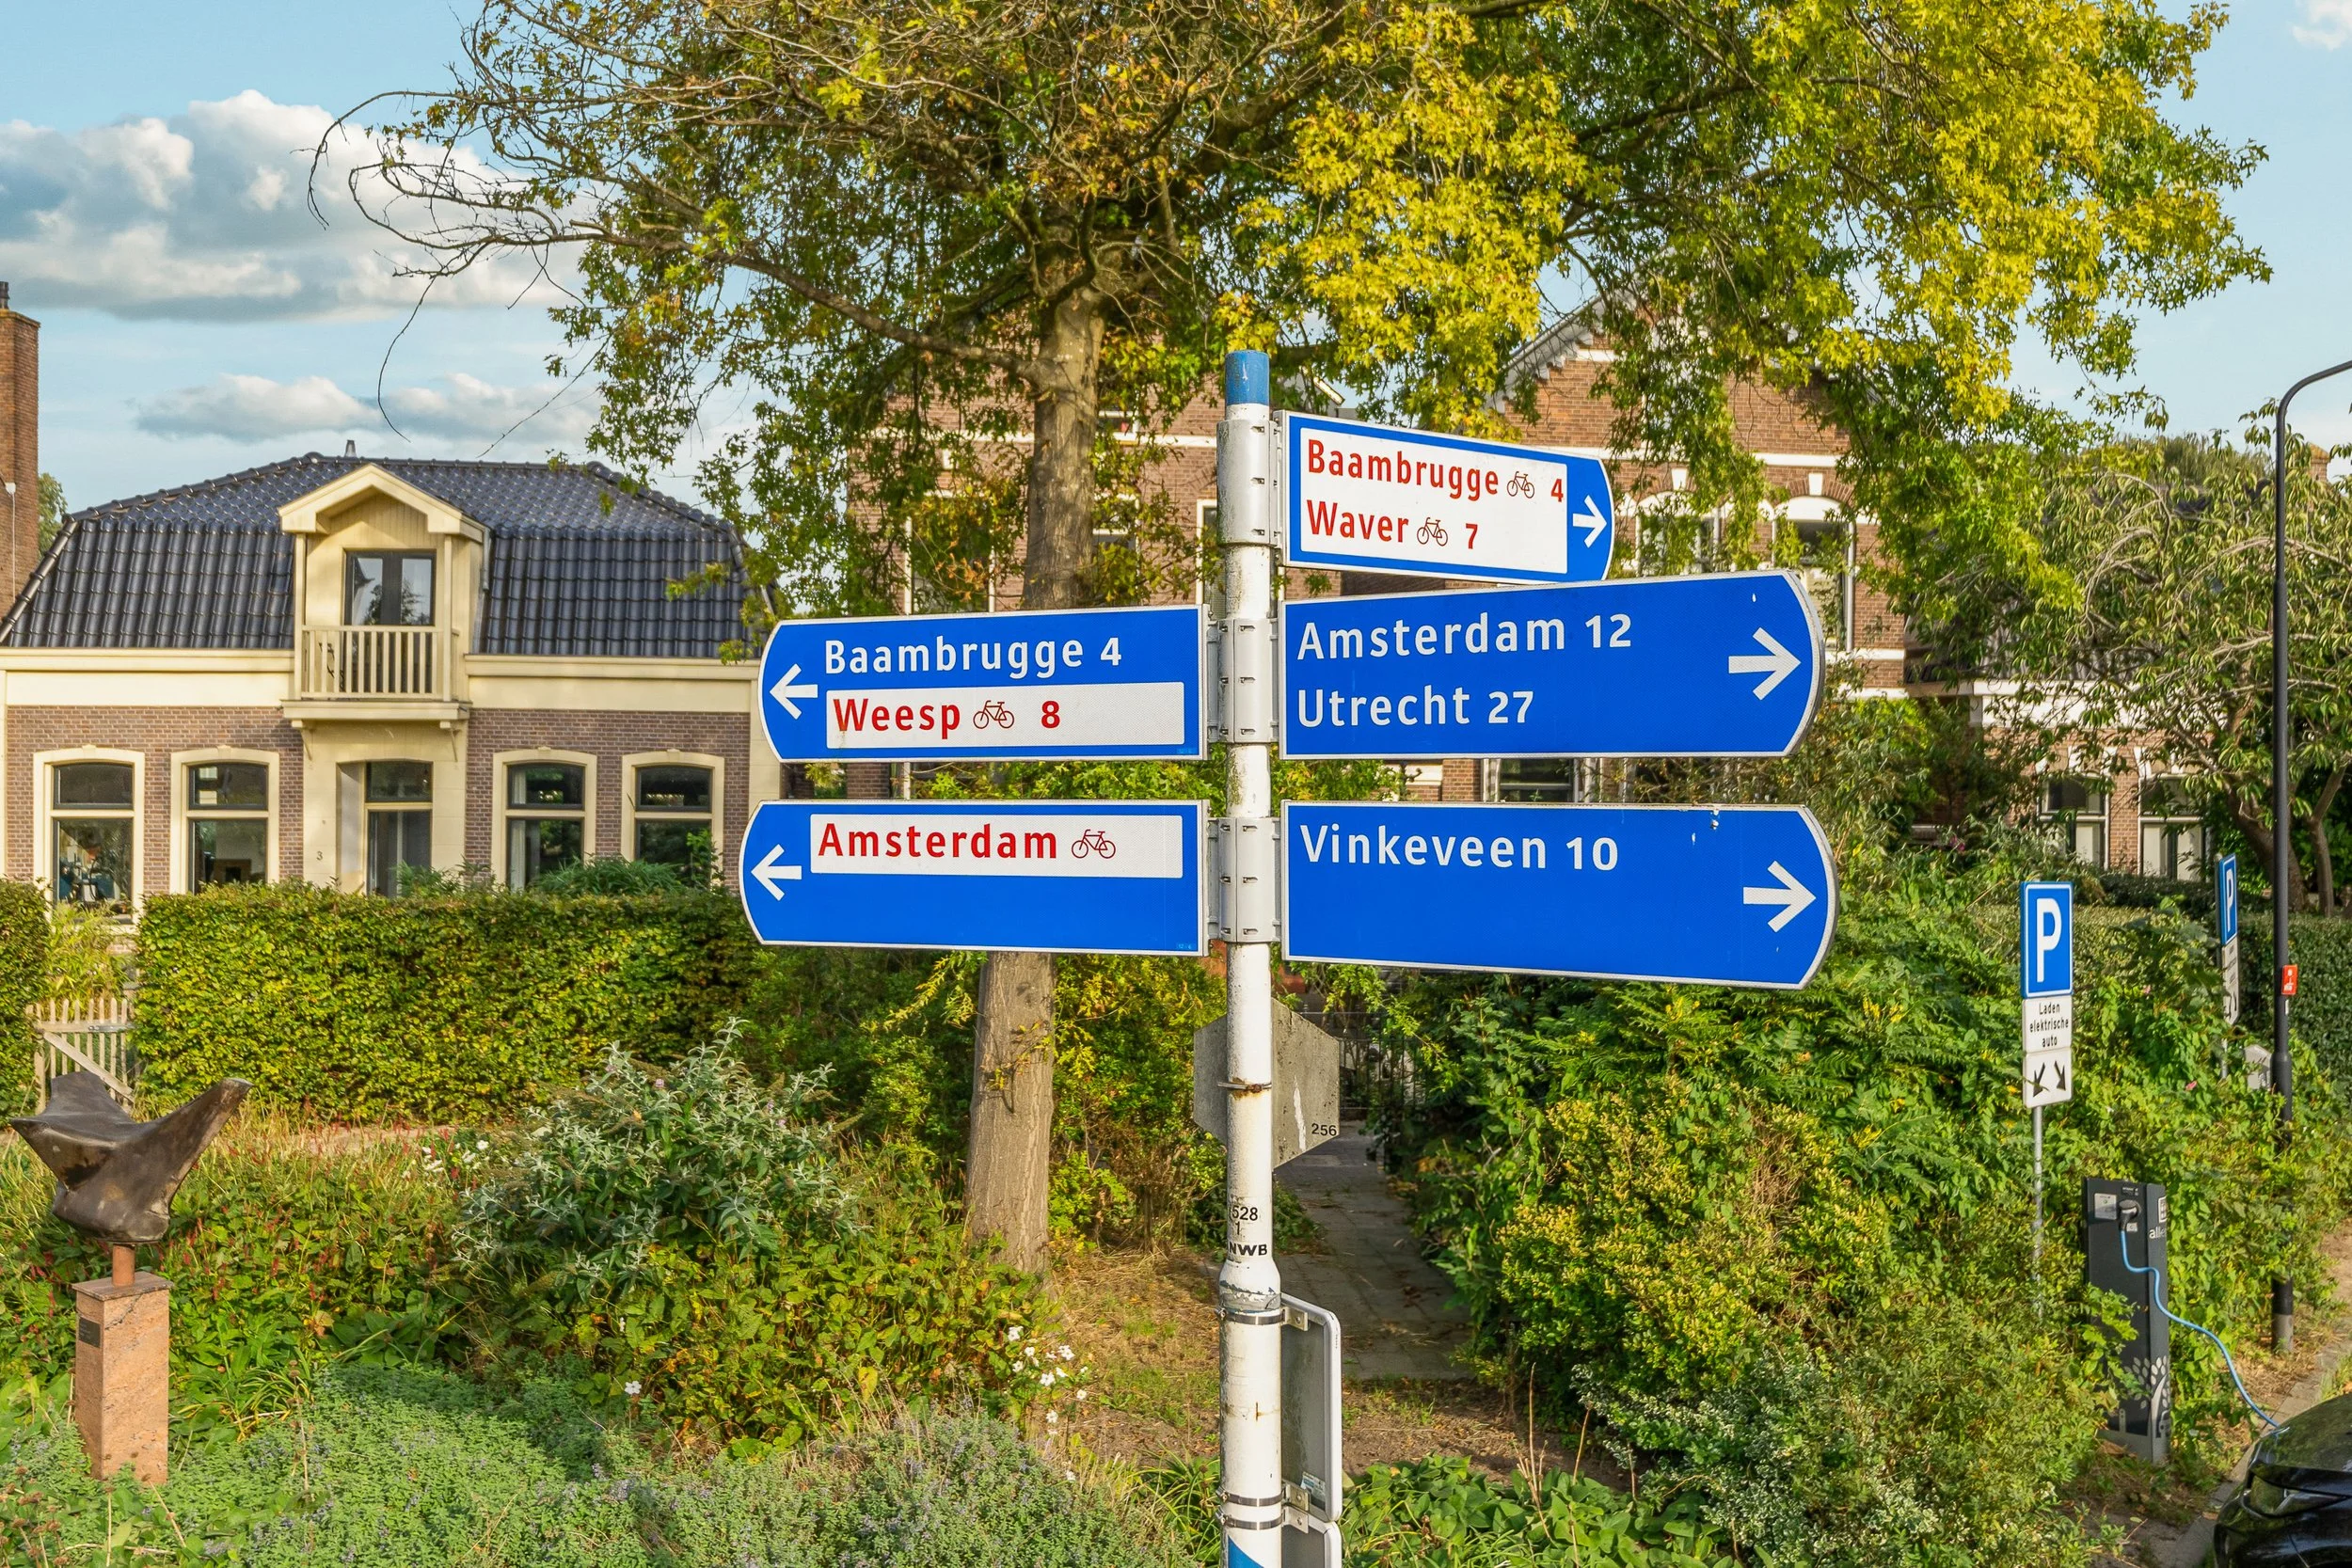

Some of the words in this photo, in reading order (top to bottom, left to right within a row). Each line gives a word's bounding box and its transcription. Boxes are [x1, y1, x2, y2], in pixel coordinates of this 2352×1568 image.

[1307, 439, 1499, 502] Baambrugge
[1550, 478, 1565, 502] 4
[1307, 499, 1409, 543] Waver
[1465, 523, 1478, 549] 7
[825, 635, 1083, 679] Baambrugge
[1100, 637, 1122, 666] 4
[1297, 611, 1565, 660] Amsterdam
[1585, 613, 1631, 648] 12
[833, 697, 961, 740] Weesp
[1041, 700, 1061, 729] 8
[1298, 685, 1470, 728] Utrecht
[1488, 690, 1534, 724] 27
[316, 850, 324, 861] 3
[818, 822, 1057, 859] Amsterdam
[1299, 823, 1546, 869] Vinkeveen
[1565, 836, 1618, 871] 10
[2226, 868, 2233, 933] P
[2036, 897, 2062, 983] P
[2029, 1017, 2069, 1033] elektrische
[2039, 1002, 2060, 1015] Laden
[2042, 1035, 2058, 1048] auto
[1311, 1122, 1337, 1136] 256
